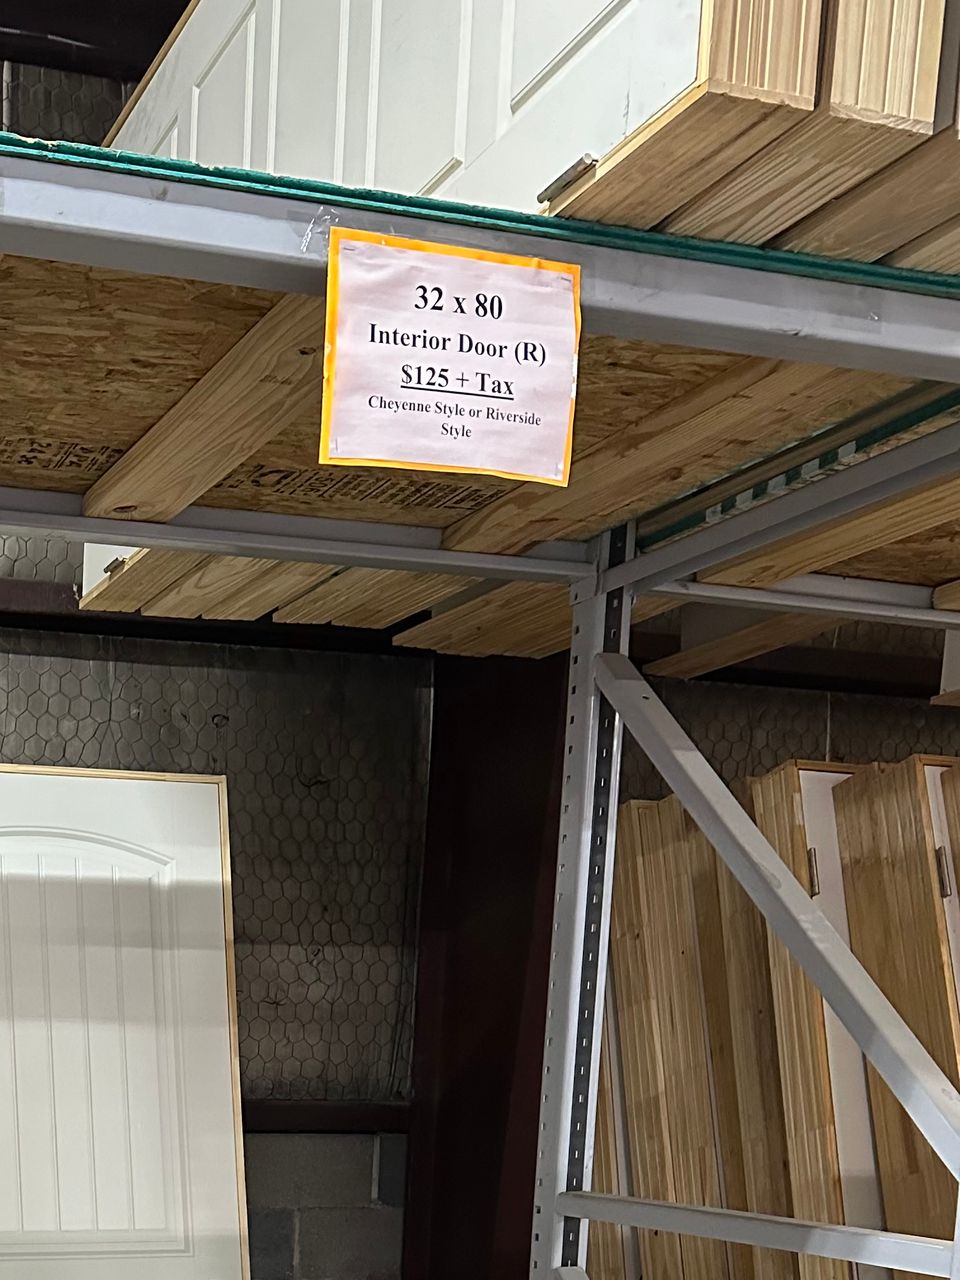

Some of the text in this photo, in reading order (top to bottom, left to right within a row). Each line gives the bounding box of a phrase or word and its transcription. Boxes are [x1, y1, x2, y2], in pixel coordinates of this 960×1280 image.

[414, 285, 502, 319] 32 x 80
[368, 323, 546, 367] Interior Door (R)
[401, 364, 514, 395] $125 + Tax
[368, 395, 541, 426] Cheyenne Style or Riverside
[440, 422, 472, 440] Style
